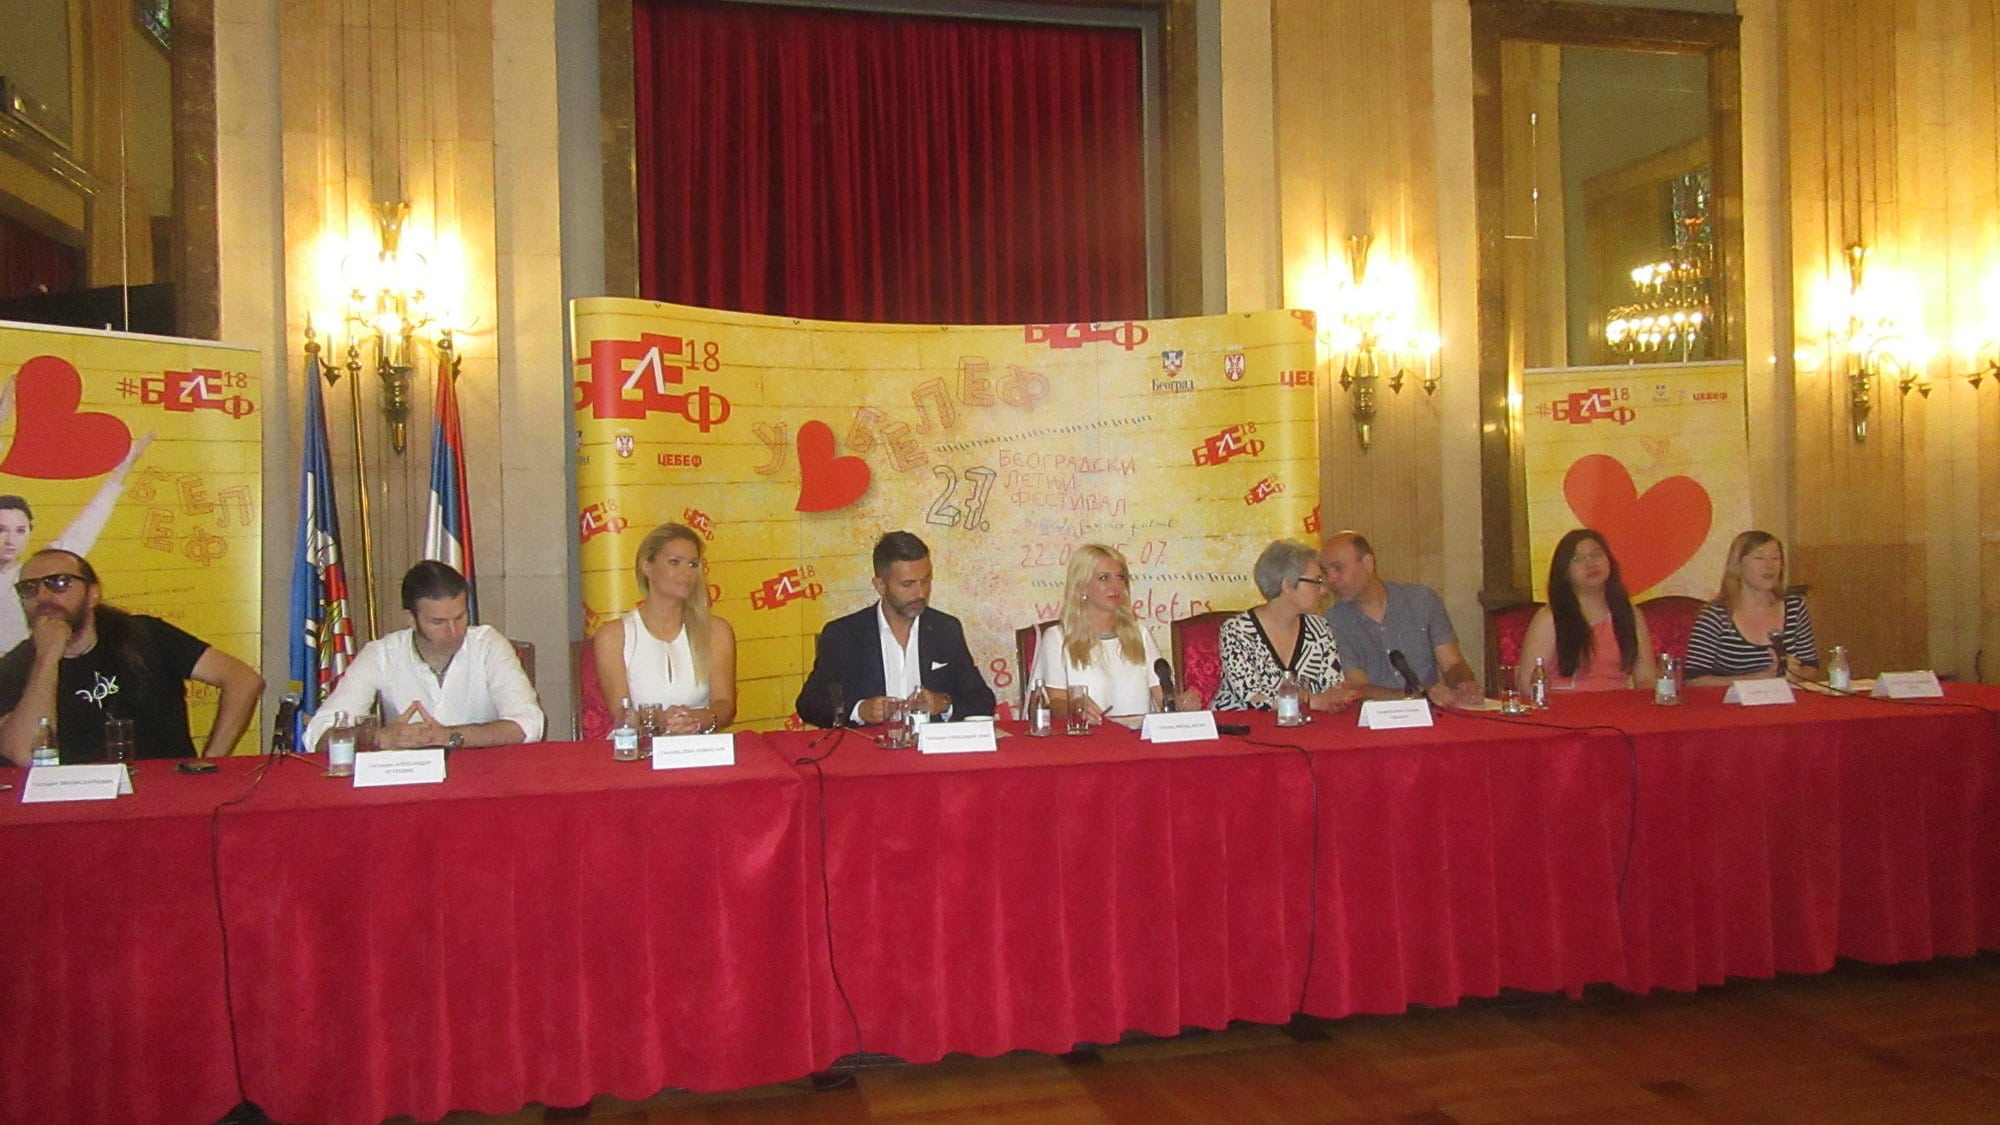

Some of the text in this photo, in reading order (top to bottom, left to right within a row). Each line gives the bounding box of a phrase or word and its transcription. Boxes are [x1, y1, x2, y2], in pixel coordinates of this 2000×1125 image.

[685, 339, 720, 372] 18
[224, 371, 248, 388] 18
[1612, 388, 1630, 400] 18
[657, 453, 703, 468] ЦЕБЕФ
